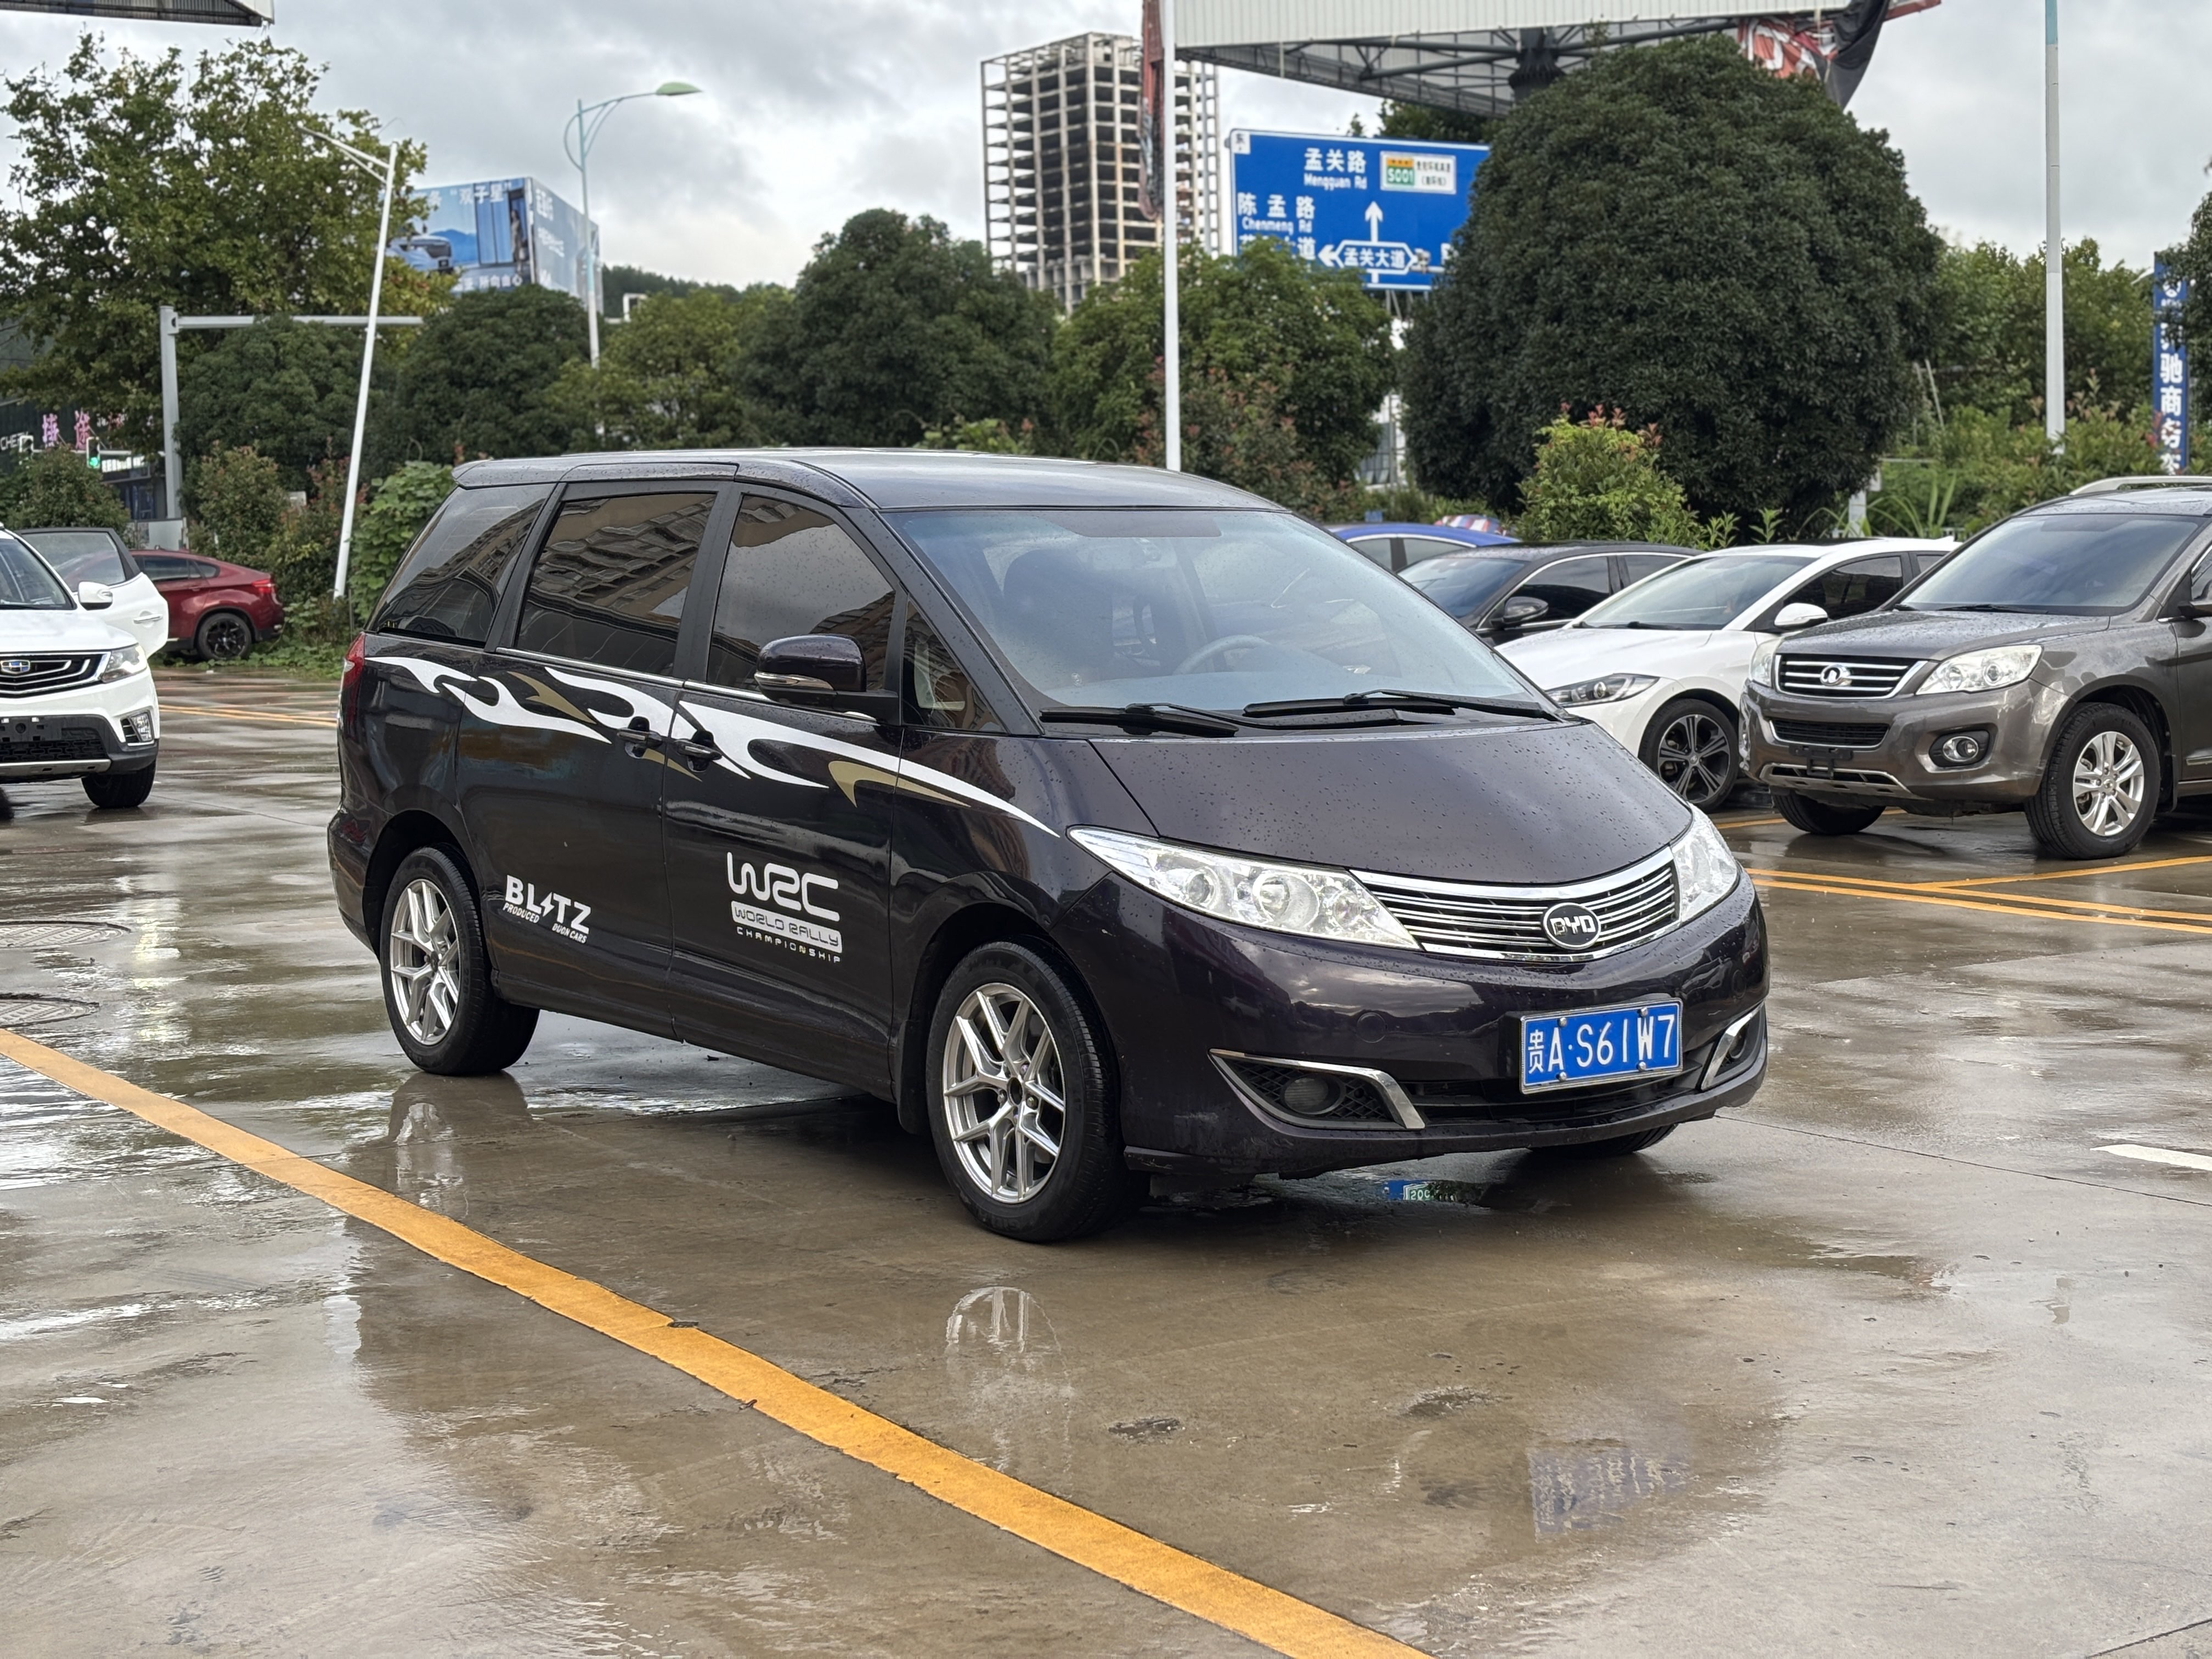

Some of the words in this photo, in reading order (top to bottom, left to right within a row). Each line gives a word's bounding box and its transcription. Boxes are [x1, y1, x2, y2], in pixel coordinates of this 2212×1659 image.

[1304, 147, 1367, 174] 孟关路
[1304, 173, 1351, 191] Mengguan
[1354, 175, 1367, 190] Rd
[1387, 167, 1414, 184] S001
[1237, 192, 1316, 219] 陈孟路
[1242, 216, 1294, 236] Chenmeng
[1299, 219, 1313, 233] Rd
[1344, 247, 1406, 269] 孟关大道
[727, 851, 840, 922] WRC
[503, 902, 540, 924] PRODUCED
[505, 874, 591, 935] BLITZ
[734, 906, 785, 931] WORLD
[788, 923, 839, 947] RALLY
[1550, 915, 1596, 936] BYD
[569, 930, 588, 944] CARS
[736, 926, 841, 963] CHAMPIONSHIP
